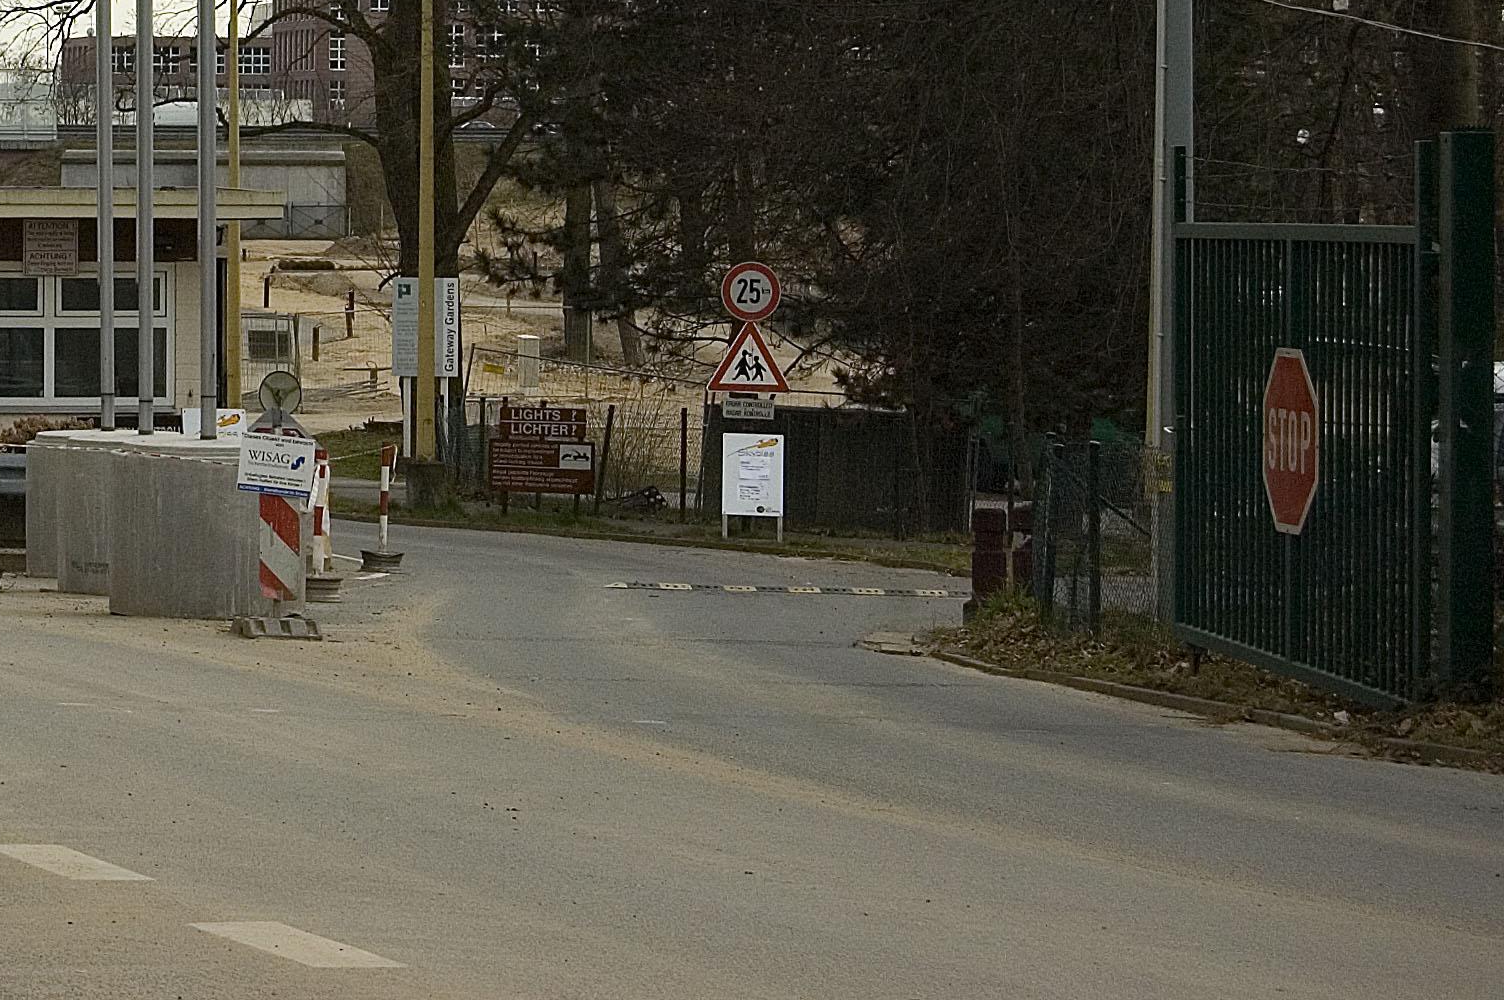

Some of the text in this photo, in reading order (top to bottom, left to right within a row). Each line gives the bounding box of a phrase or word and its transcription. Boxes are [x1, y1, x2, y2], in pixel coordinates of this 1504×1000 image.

[737, 278, 761, 304] 25
[444, 282, 457, 373] Gateway Gardens
[511, 409, 561, 421] LIGHTS
[511, 423, 568, 436] LICHTER
[1267, 408, 1311, 475] STOP
[248, 450, 290, 464] WISAG
